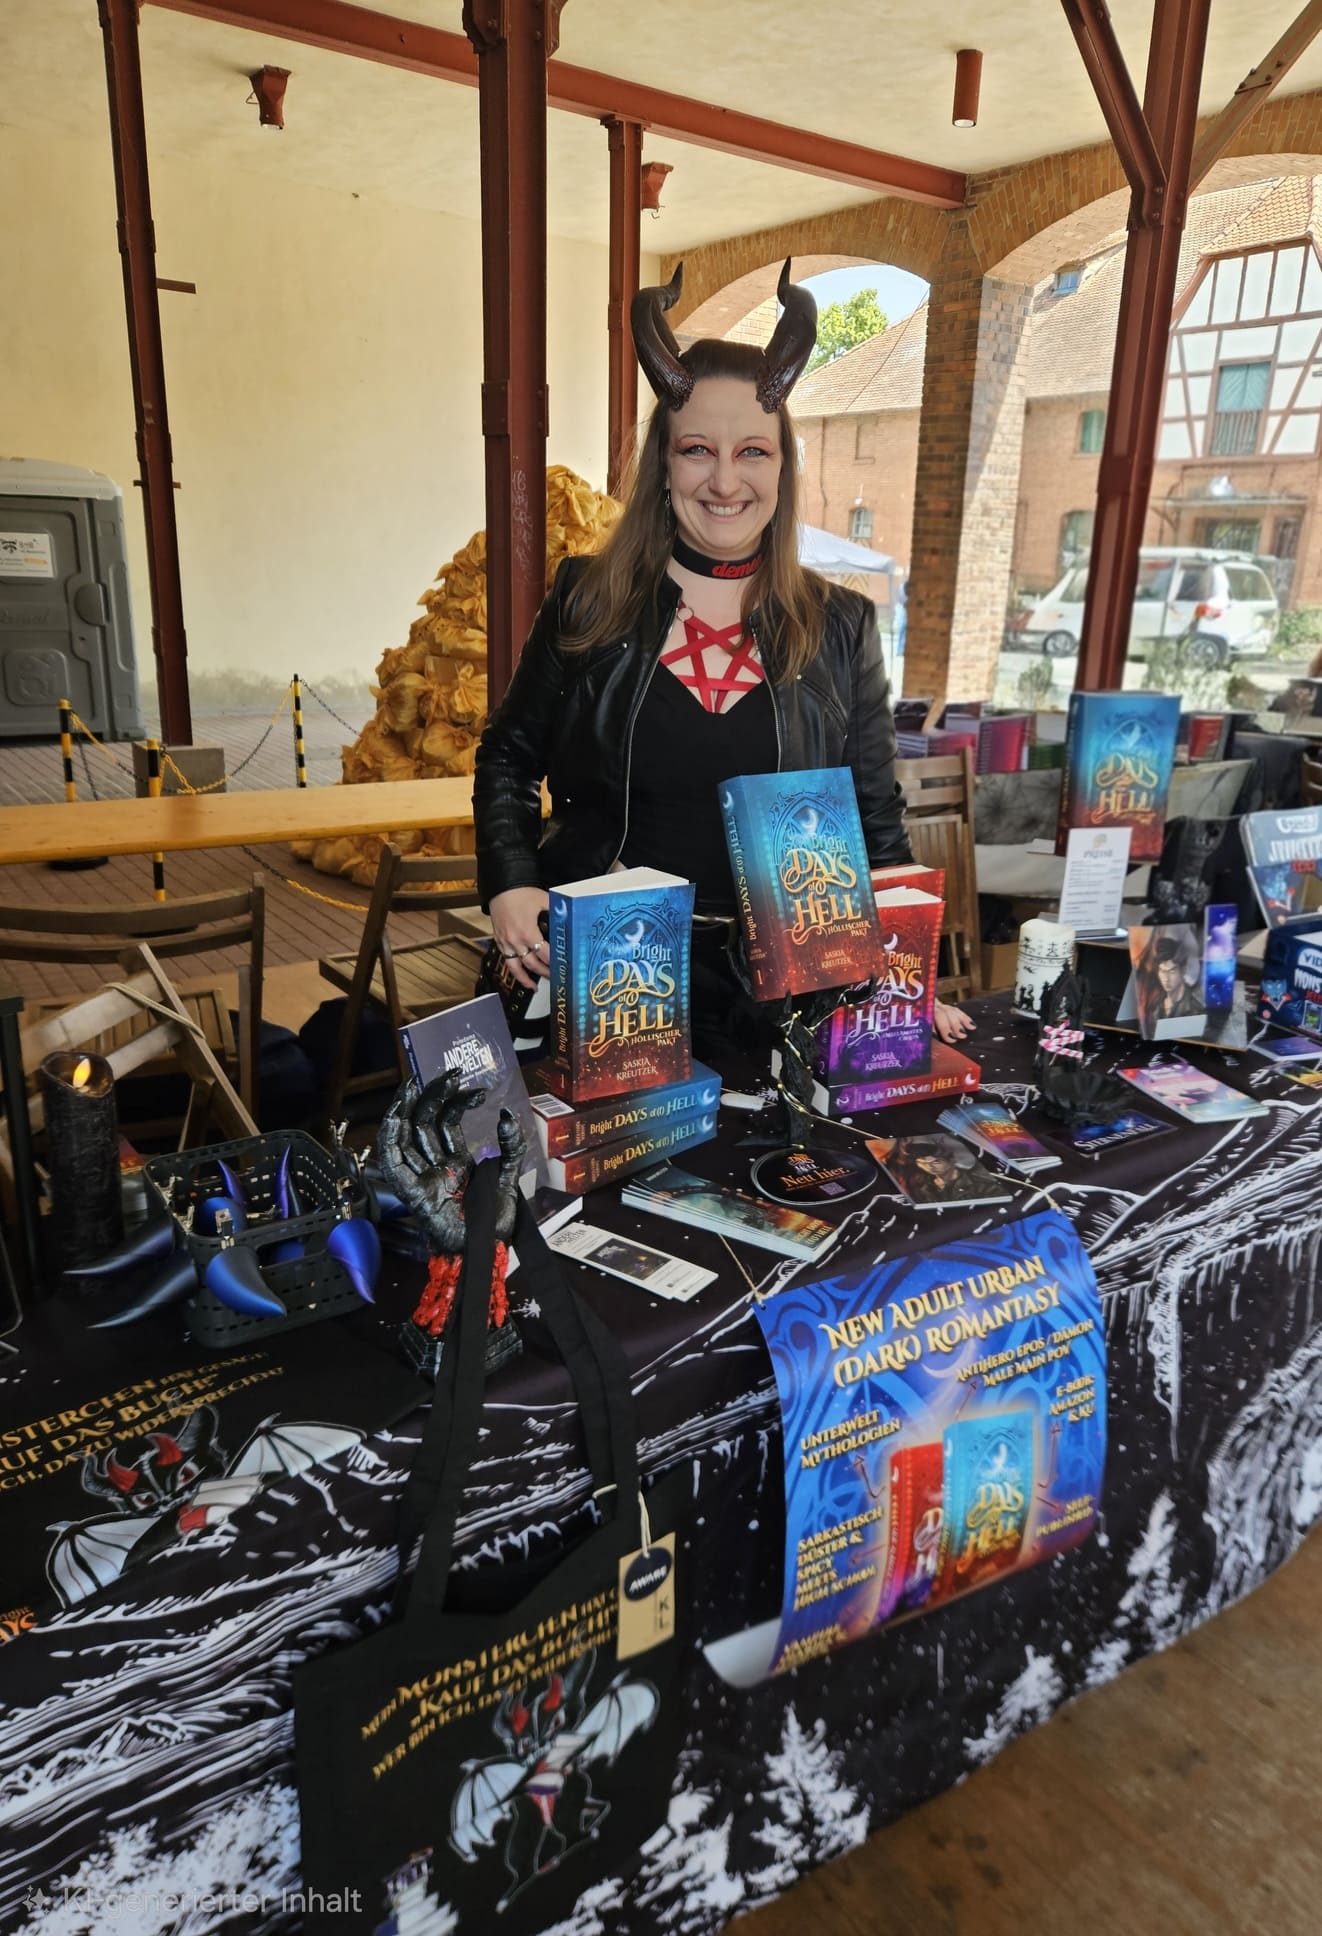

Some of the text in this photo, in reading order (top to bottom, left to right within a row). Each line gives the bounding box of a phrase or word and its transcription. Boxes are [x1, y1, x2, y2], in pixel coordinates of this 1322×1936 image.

[781, 848, 857, 893] DAYS
[792, 891, 861, 944] HELL
[556, 926, 567, 965] HELL
[633, 942, 672, 961] Bright
[888, 951, 922, 969] Bright
[590, 959, 675, 1006] DAYS
[876, 967, 924, 1000] AYS
[588, 1003, 673, 1057] HELL
[846, 1003, 920, 1048] HELL
[443, 1039, 480, 1071] ANDERE
[616, 1067, 660, 1081] KREUTZER
[623, 1057, 651, 1069] SASKIA
[886, 1084, 916, 1098] DAYS
[931, 1077, 959, 1093] HELL
[590, 1119, 612, 1135] Bright
[614, 1107, 648, 1127] DAYS
[666, 1095, 697, 1116] HELL
[603, 1154, 624, 1171] Bright
[625, 1138, 655, 1162] DAYS
[671, 1122, 697, 1145] HELL
[819, 1255, 1046, 1350] NEW ADULT URBAN
[834, 1282, 1062, 1387] (DARK) ROMANTASY
[956, 1348, 1015, 1380] ANTIHERO
[1016, 1337, 1045, 1358] EPOS
[983, 1365, 1015, 1387] MALE
[1014, 1352, 1047, 1374] MAIN
[0, 1379, 156, 1449] STERCHEN
[51, 1416, 115, 1451] DAS
[801, 1409, 880, 1450] UNTERWELT
[801, 1418, 901, 1469] MYTHOLOGIEN
[0, 1470, 43, 1491] CH,
[798, 1505, 883, 1552] SARKASTISCH
[849, 1529, 864, 1544] &
[629, 1564, 667, 1593] AWARE
[797, 1556, 834, 1580] SPICY
[397, 1602, 578, 1705] MONSTERCHEN
[493, 1650, 537, 1686] DAS
[372, 1743, 407, 1781] WER
[408, 1717, 436, 1749] BIN
